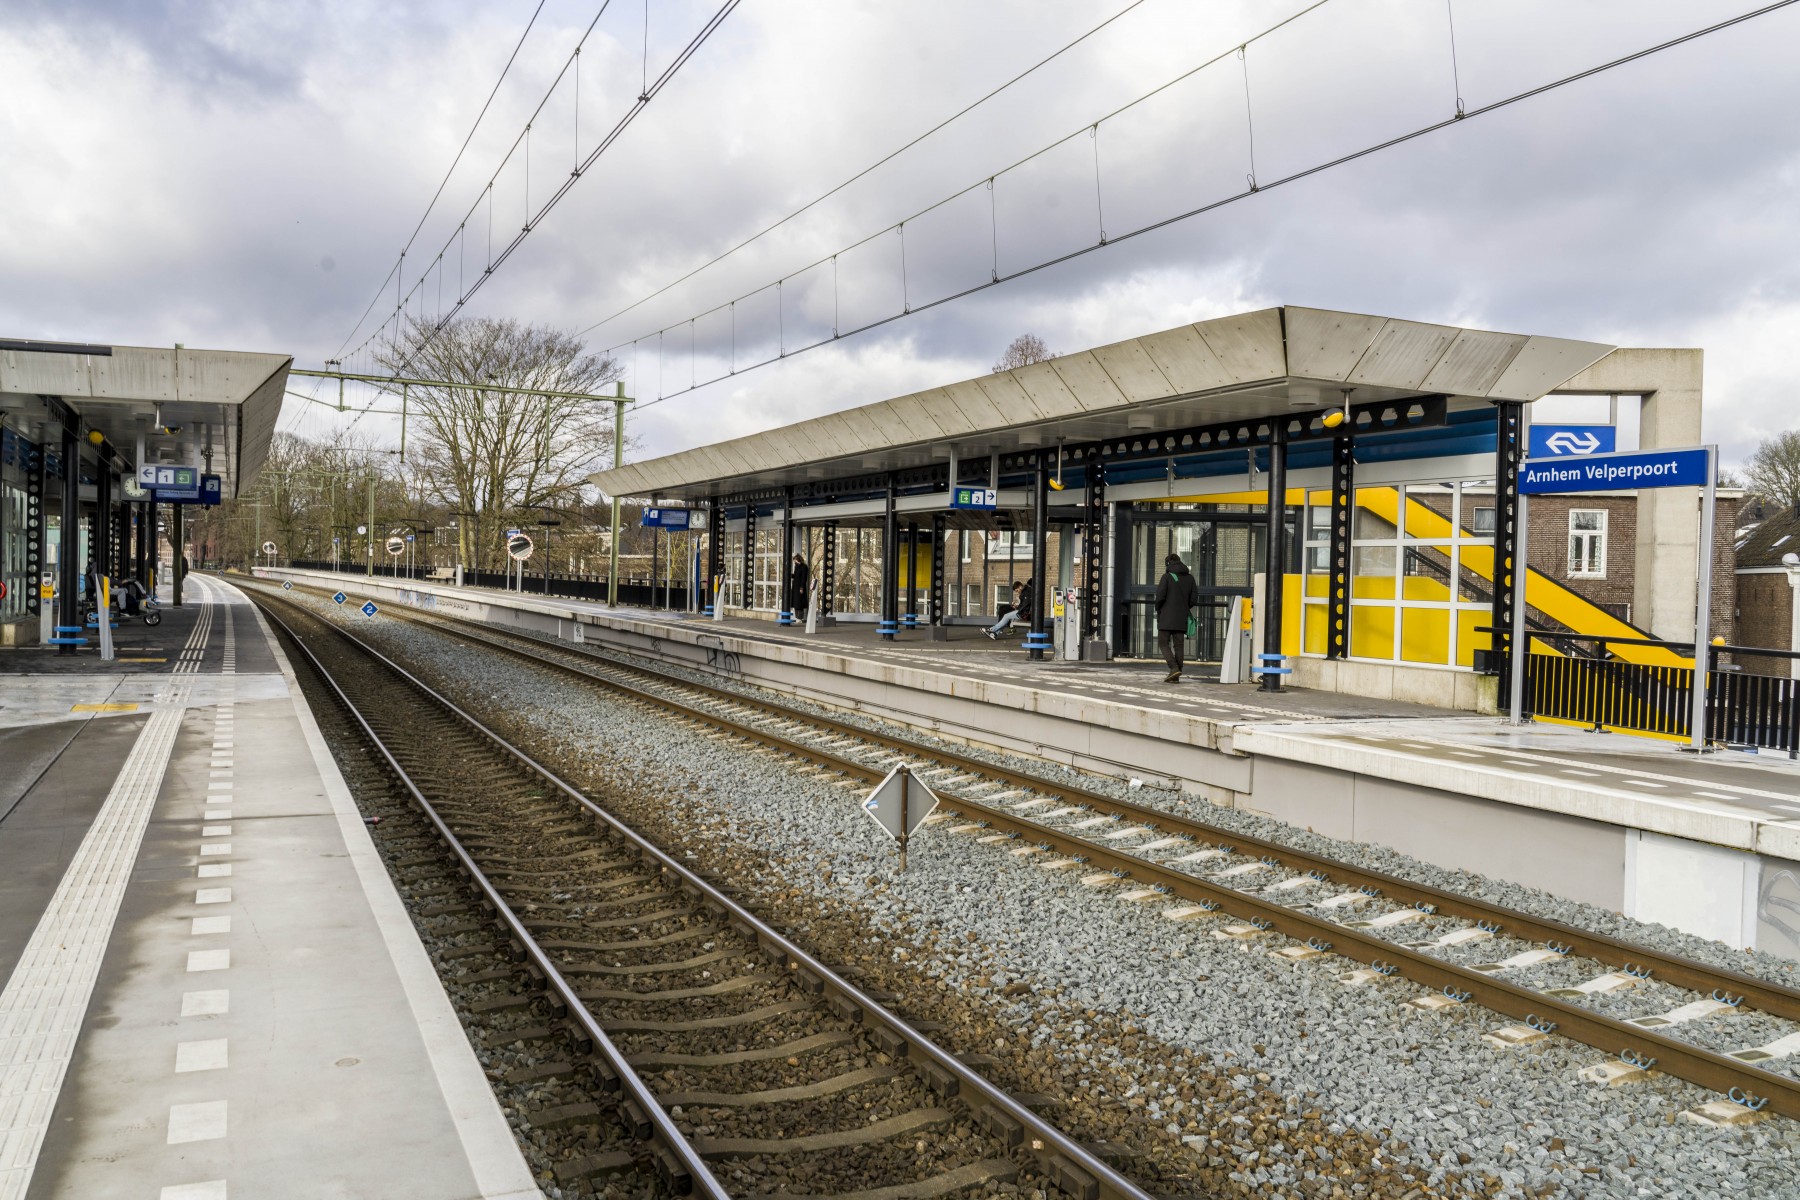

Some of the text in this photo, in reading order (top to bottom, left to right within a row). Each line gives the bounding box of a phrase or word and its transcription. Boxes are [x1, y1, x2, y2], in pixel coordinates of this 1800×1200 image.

[1526, 461, 1678, 483] Arnhem Velperpoort
[337, 594, 343, 602] 3
[366, 605, 373, 613] 2
